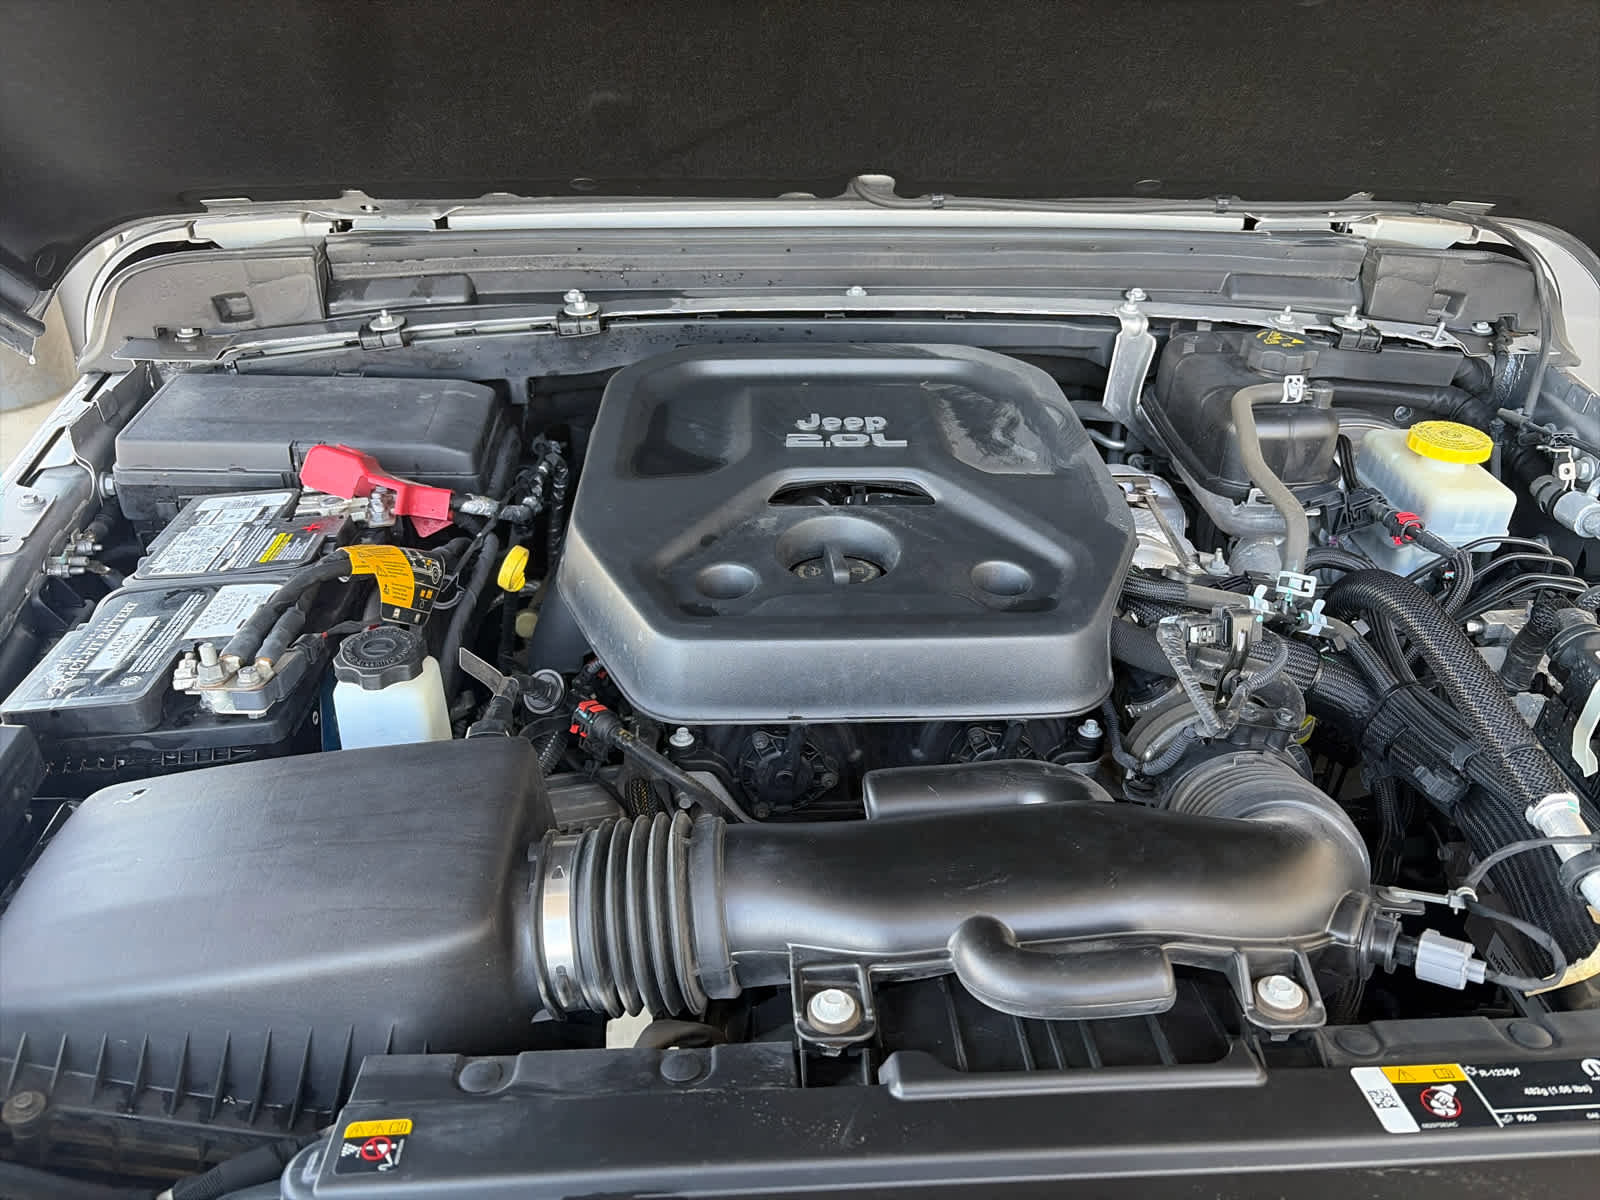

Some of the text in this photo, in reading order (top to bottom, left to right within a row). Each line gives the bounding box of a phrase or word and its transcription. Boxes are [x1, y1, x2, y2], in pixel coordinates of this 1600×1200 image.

[795, 413, 887, 433] Jeep
[785, 433, 908, 448] 2.0L
[95, 601, 139, 643] BATTERY
